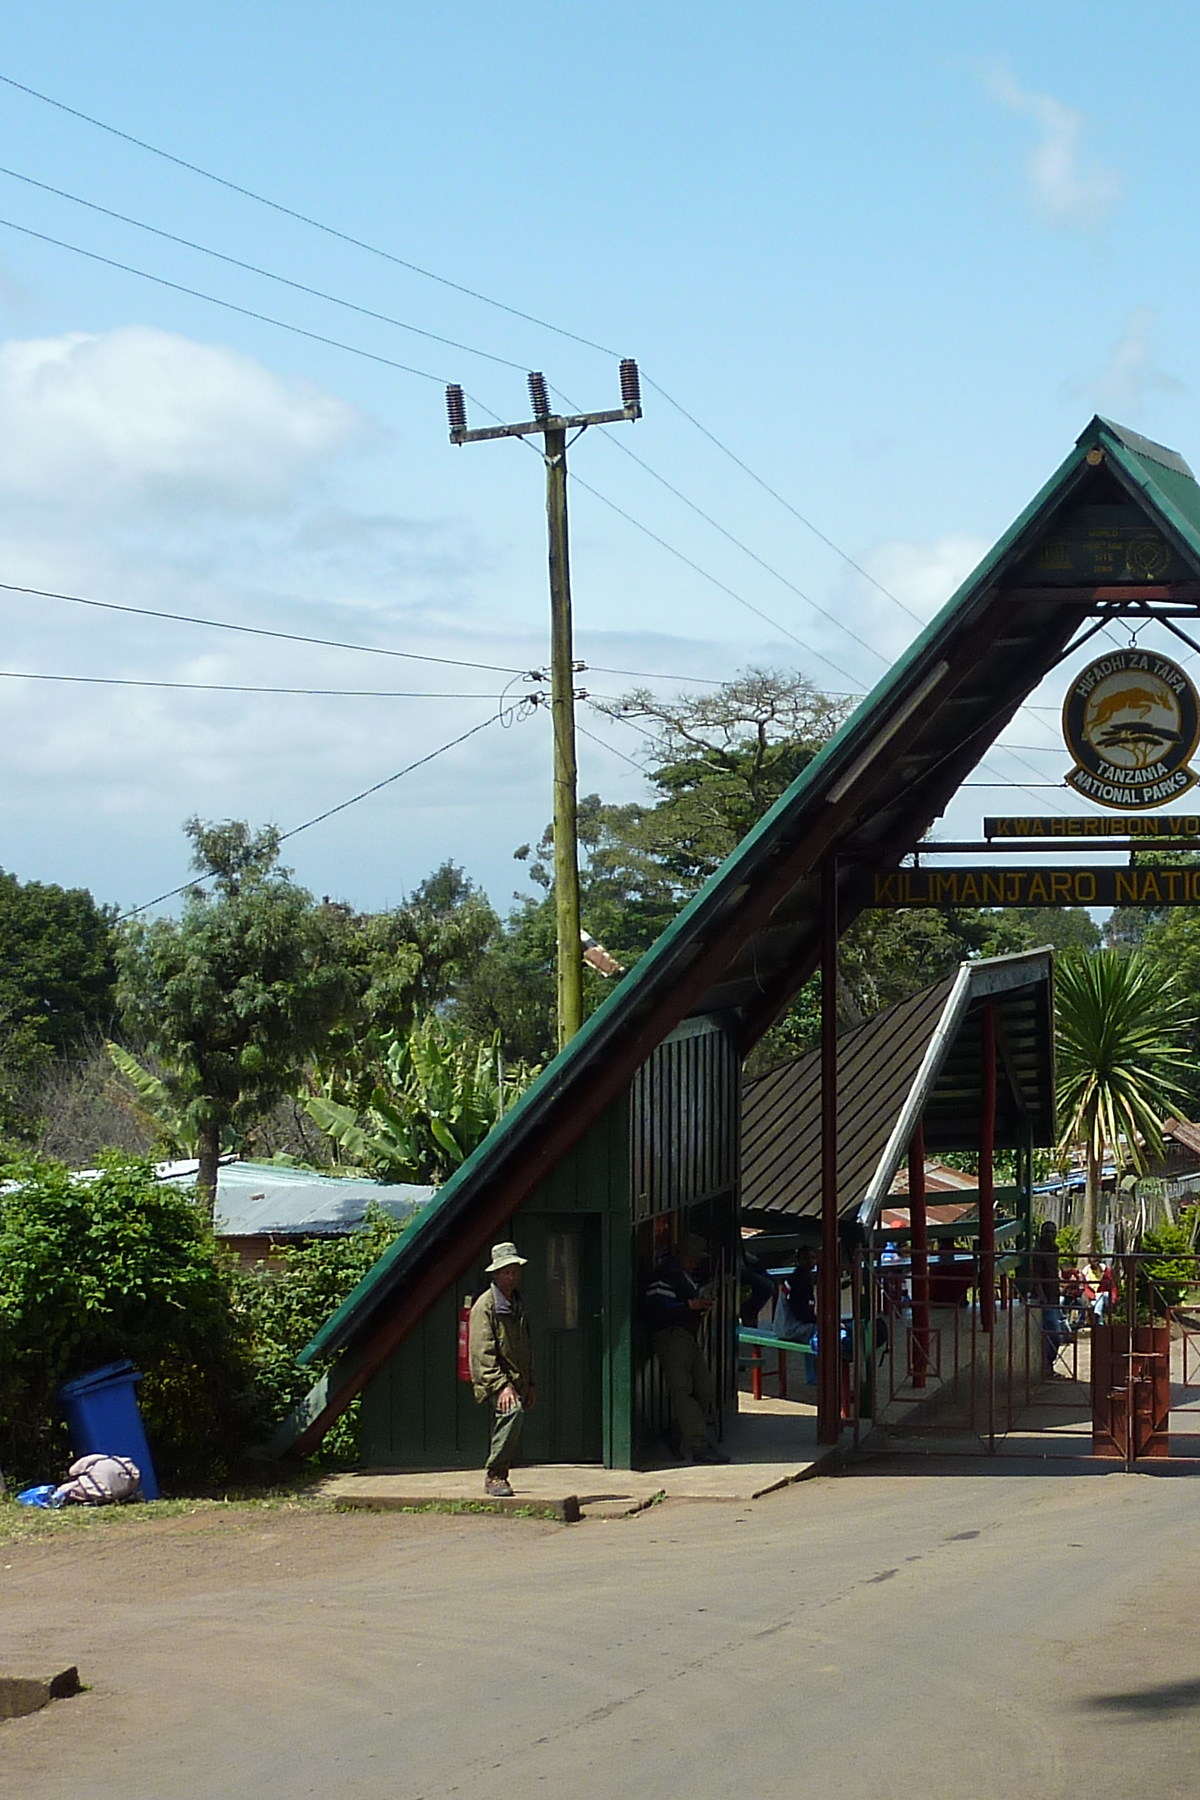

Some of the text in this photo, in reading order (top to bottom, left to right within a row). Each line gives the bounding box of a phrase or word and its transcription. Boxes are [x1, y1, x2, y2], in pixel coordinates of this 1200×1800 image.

[1076, 654, 1187, 697] HIFADHI ZA TAIFA
[1073, 770, 1188, 804] NATIONAL PARKS
[1096, 760, 1169, 783] TANZANIA
[874, 872, 1097, 903] KILIMANJARO
